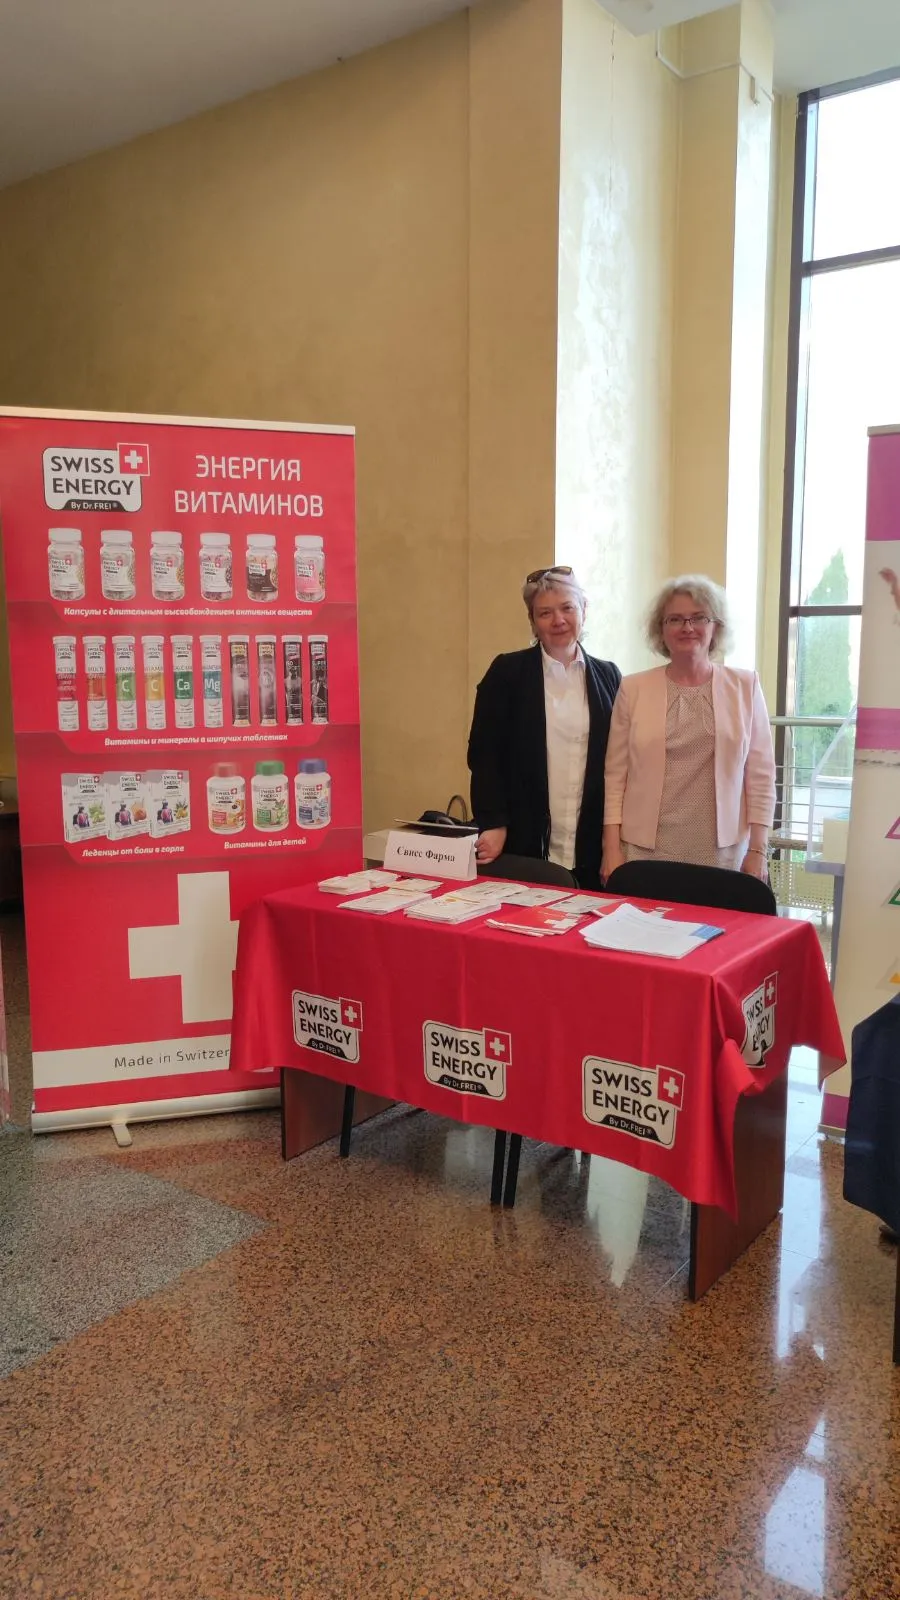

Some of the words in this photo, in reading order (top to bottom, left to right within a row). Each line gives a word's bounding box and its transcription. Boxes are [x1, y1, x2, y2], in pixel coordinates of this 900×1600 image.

[50, 456, 114, 474] SWISS
[196, 454, 300, 482] ЭНЕРГИЯ
[52, 478, 134, 496] ENERGY
[71, 502, 82, 510] By
[174, 490, 324, 517] ВИТАМИНОВ
[64, 607, 101, 617] Капсулы
[108, 607, 164, 615] длительным
[122, 680, 130, 692] C
[151, 679, 159, 692] C
[176, 678, 191, 690] Ca
[204, 678, 221, 692] Mg
[105, 737, 150, 746] Витамины
[158, 736, 199, 745] минералы
[206, 736, 242, 744] шипучих
[224, 841, 267, 849] Витамины
[282, 837, 307, 845] детей
[82, 849, 119, 857] Леденцы
[134, 846, 154, 854] боли
[396, 846, 423, 858] Свисс
[425, 850, 456, 862] Фарма
[298, 1000, 338, 1023] SWISS
[300, 1018, 352, 1045] ENERGY
[431, 1031, 480, 1056] SWISS
[114, 1055, 153, 1068] Made
[159, 1053, 171, 1063] in
[432, 1052, 497, 1080] ENERGY
[443, 1077, 451, 1086] By
[592, 1068, 652, 1097] SWISS
[593, 1090, 669, 1125] ENERGY
[609, 1117, 619, 1127] By
